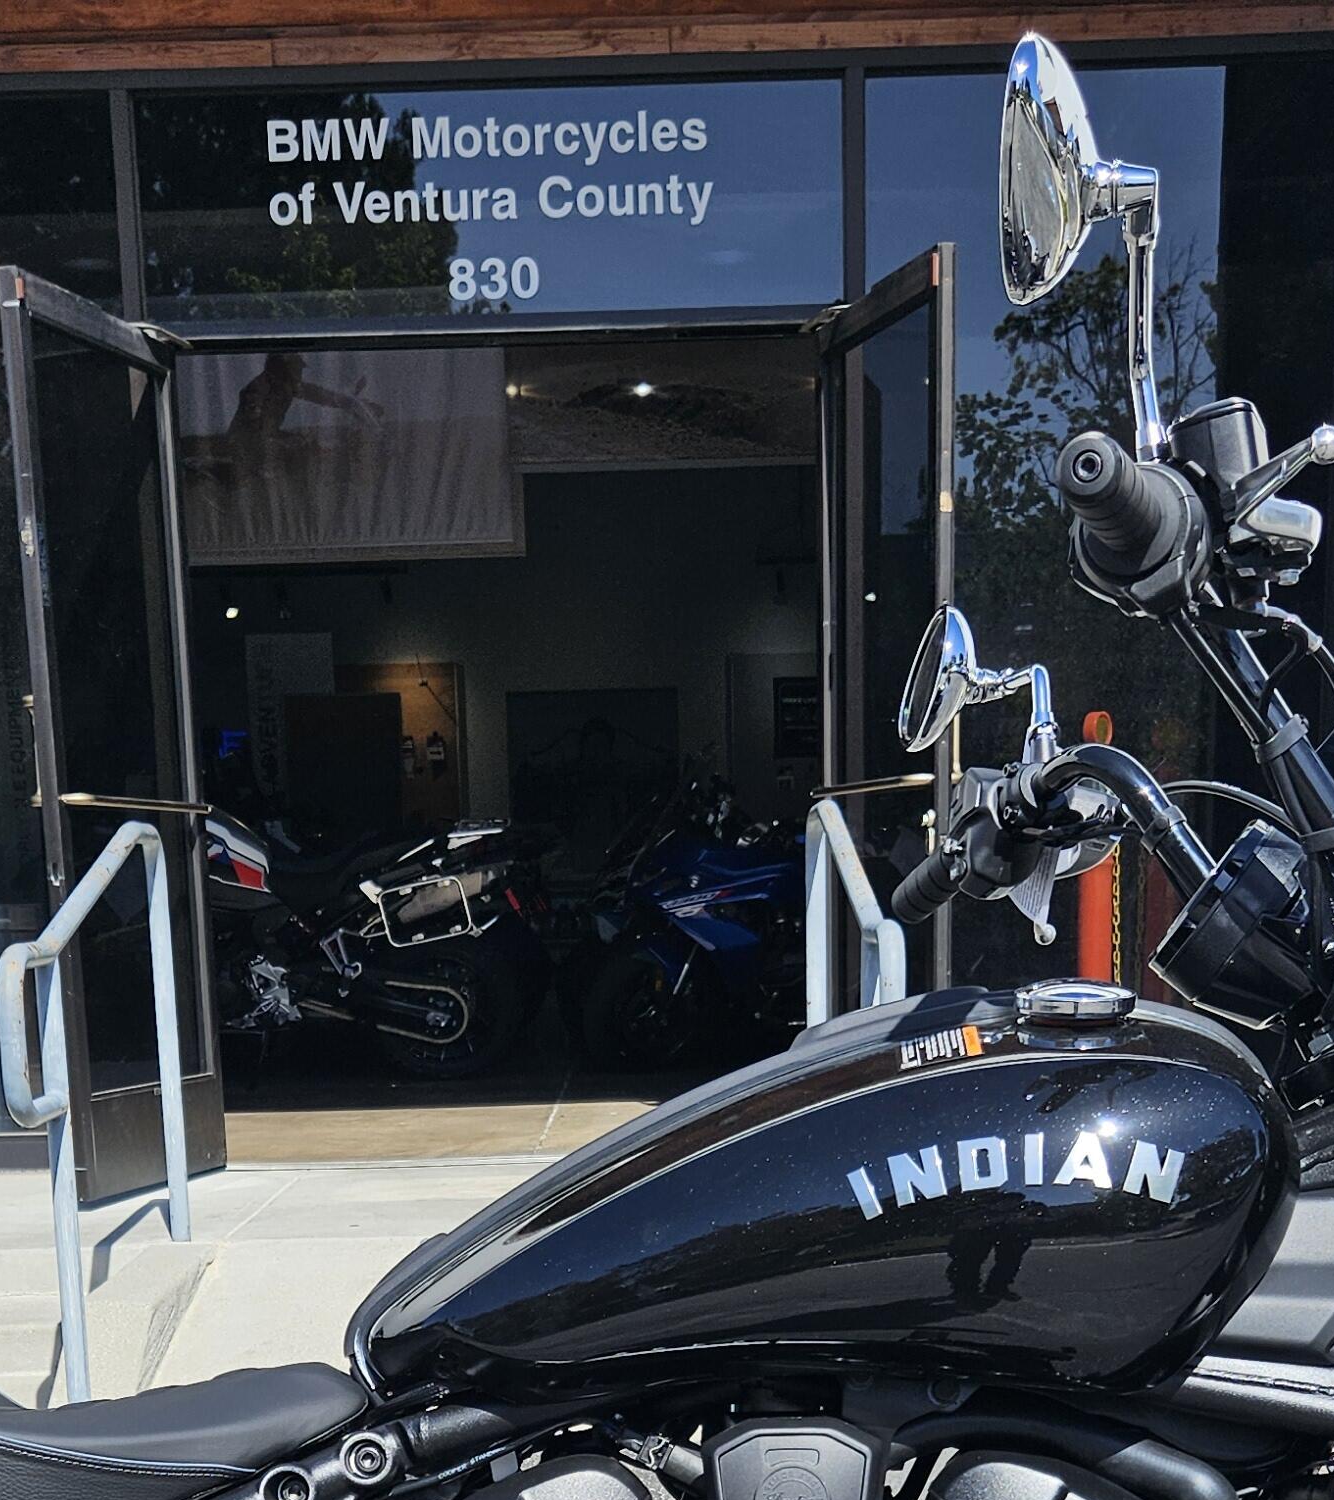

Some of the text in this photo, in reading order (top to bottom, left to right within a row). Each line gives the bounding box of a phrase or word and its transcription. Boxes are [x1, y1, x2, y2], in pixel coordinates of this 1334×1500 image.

[267, 109, 708, 166] BMW Motorcycles
[269, 173, 714, 226] of Ventura County
[448, 255, 540, 301] 830
[845, 1130, 1185, 1221] INDIAN
